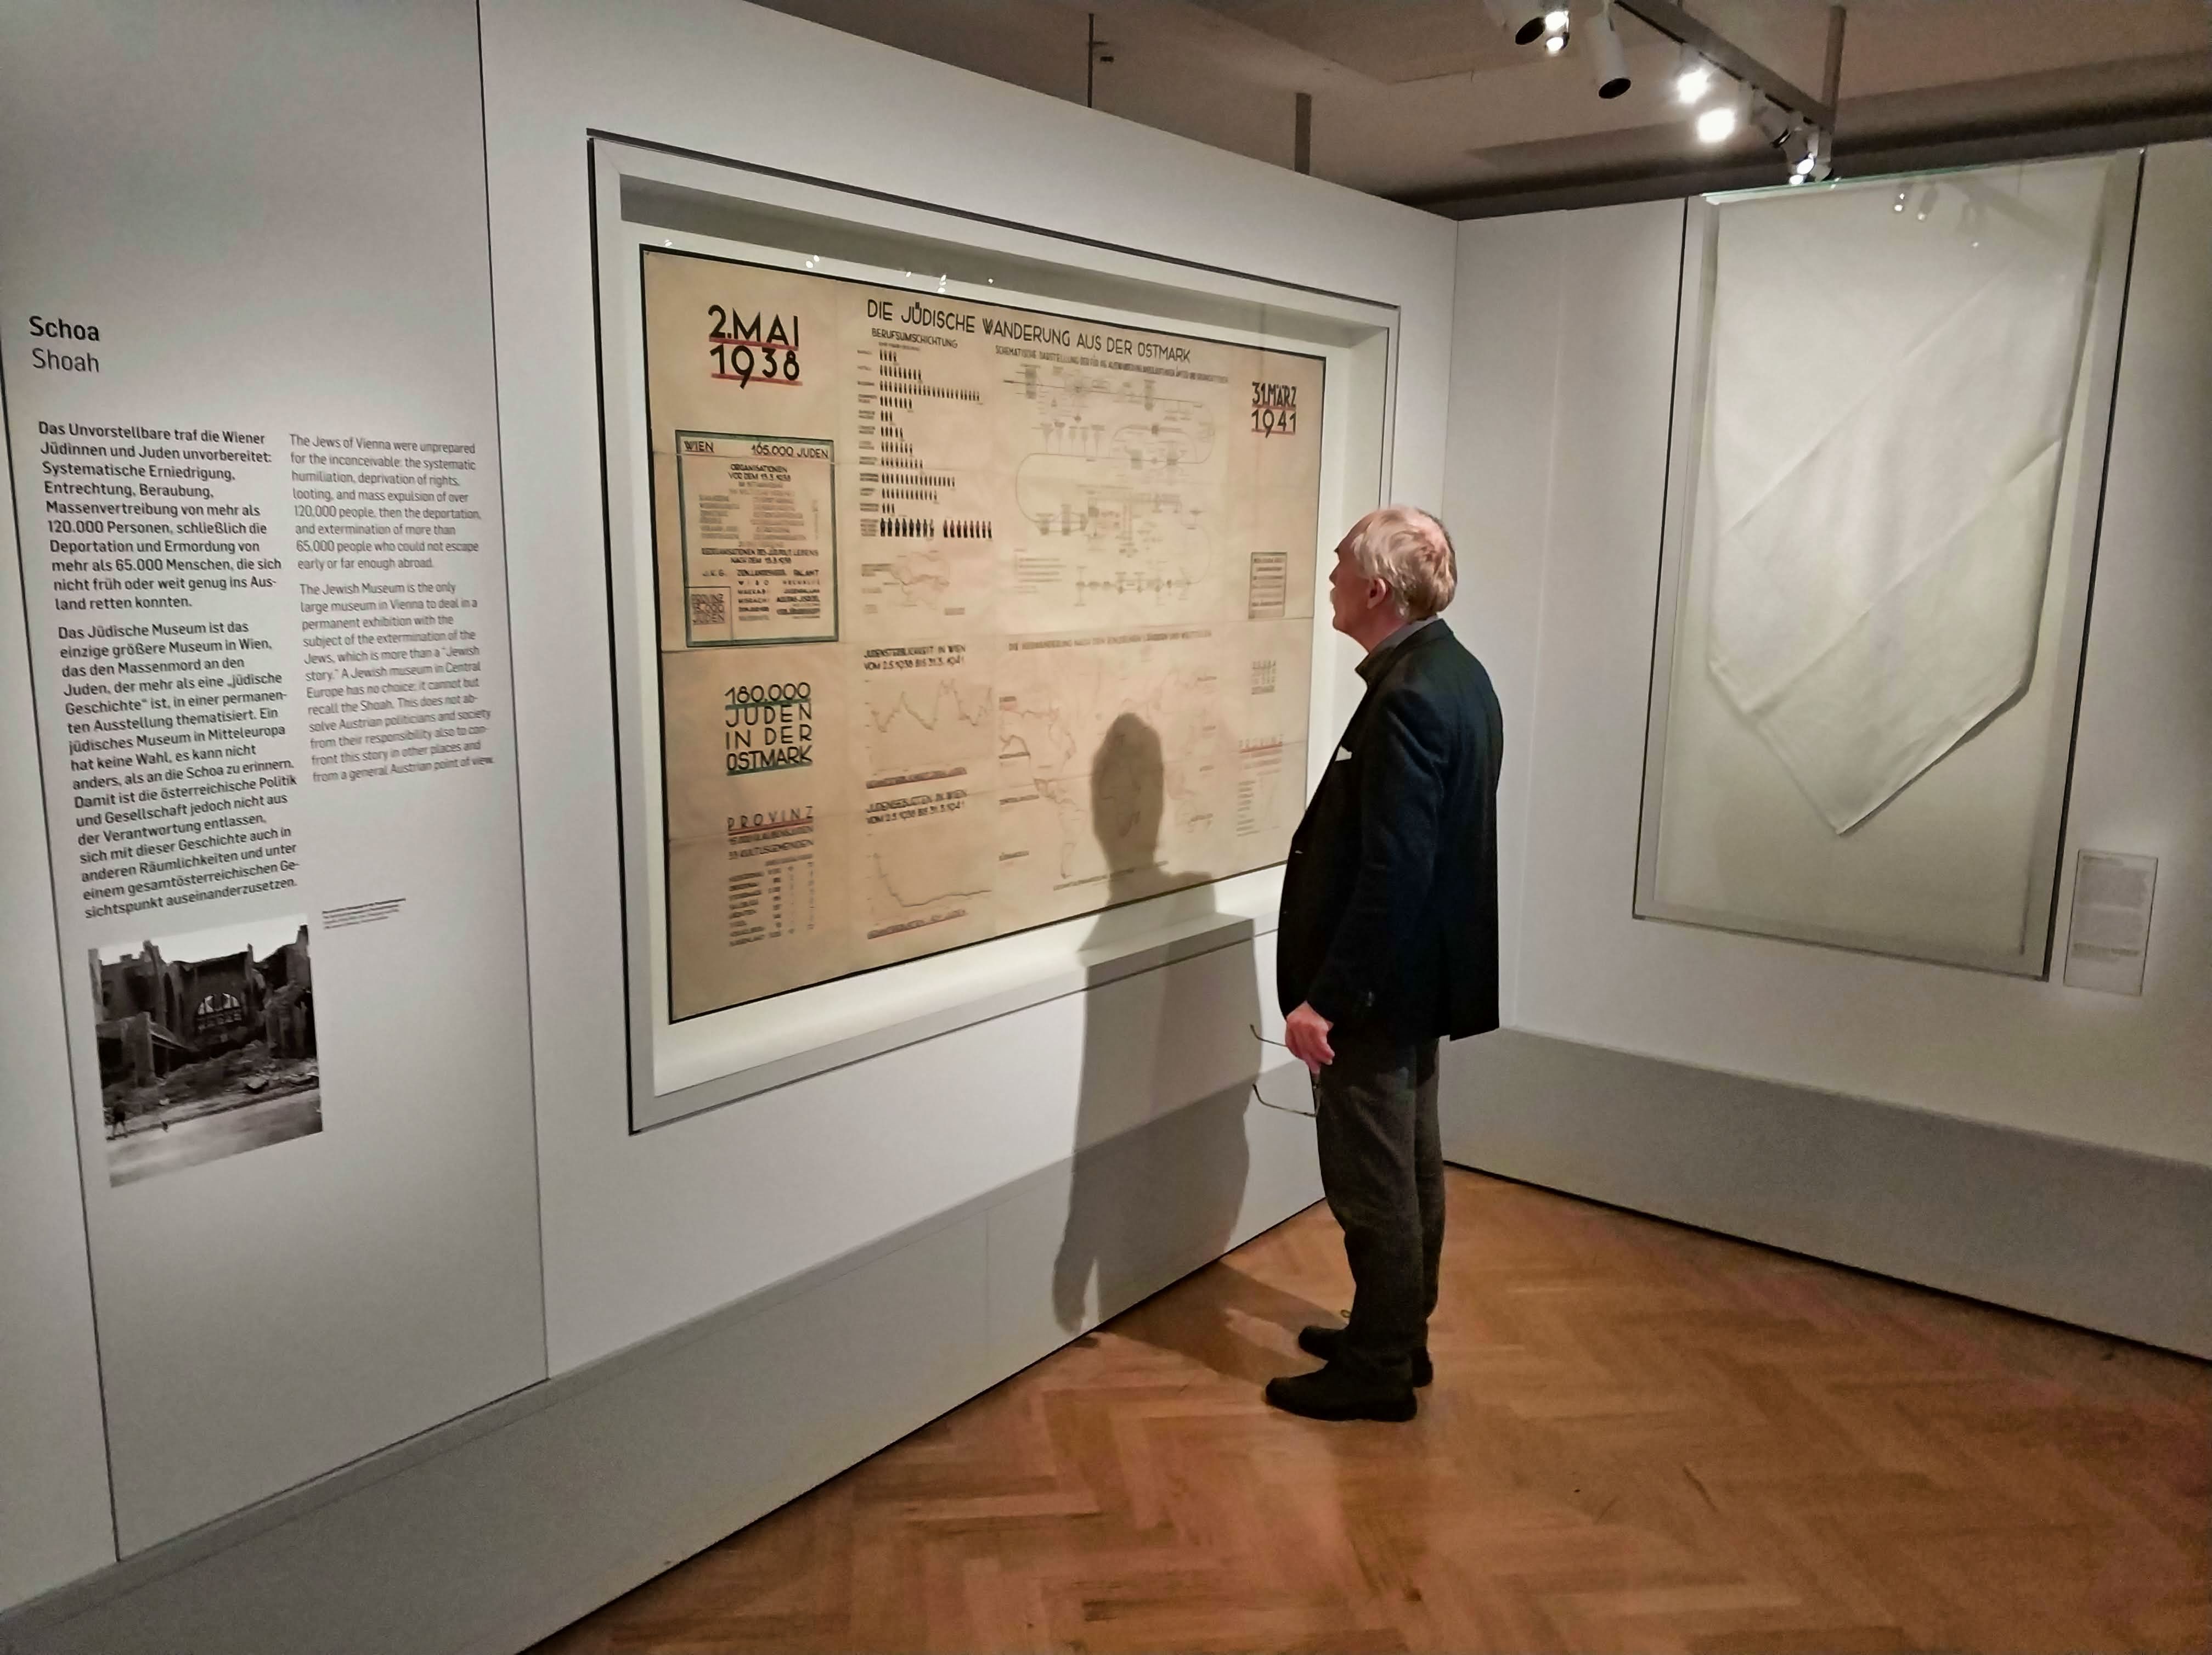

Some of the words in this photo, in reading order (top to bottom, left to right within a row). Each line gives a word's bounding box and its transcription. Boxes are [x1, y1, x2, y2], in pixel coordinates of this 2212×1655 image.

[30, 316, 100, 341] Schoa
[708, 305, 799, 347] 2.MAI
[867, 299, 893, 321] DIE
[901, 302, 975, 333] JÜDISCHE
[982, 318, 1070, 347] WANDERUNG
[1076, 333, 1102, 351] AUS
[1107, 337, 1132, 355] DER
[1138, 342, 1190, 363] OSTMARK
[871, 328, 958, 348] BERUFSUMSCHICHTUNG
[32, 347, 99, 372] Shoah
[709, 344, 800, 390] 1938
[38, 421, 66, 436] Das
[69, 423, 171, 441] Unvorstellbare
[174, 429, 198, 442] traf
[200, 429, 220, 443] die
[222, 430, 266, 445] Wiener
[1251, 408, 1296, 438] 1941
[40, 442, 108, 457] Jüdinnen
[110, 445, 136, 458] und
[138, 445, 180, 460] Juden
[290, 433, 311, 447] The
[312, 435, 342, 448] Jews
[342, 436, 354, 449] of
[355, 437, 392, 451] Vienna
[392, 442, 418, 452] were
[419, 443, 476, 454] unprepared
[684, 441, 715, 453] WIEN
[797, 447, 828, 459] JUDEN
[42, 461, 146, 477] Systematische
[289, 451, 307, 465] for
[308, 453, 328, 465] the
[404, 457, 422, 469] the
[423, 459, 476, 471] systematic
[357, 472, 416, 486] deprivation
[416, 474, 427, 486] of
[336, 489, 356, 500] and
[358, 492, 387, 501] mass
[387, 490, 436, 504] expulsion
[436, 491, 447, 503] of
[448, 493, 469, 503] over
[46, 500, 179, 519] Massenvertreibung
[180, 505, 205, 516] von
[206, 504, 239, 516] mehr
[241, 504, 261, 517] als
[378, 506, 403, 519] then
[404, 507, 421, 519] the
[49, 519, 104, 534] 120.000
[176, 521, 247, 534] schließlich
[249, 522, 267, 534] die
[295, 523, 316, 535] and
[392, 523, 403, 536] of
[405, 526, 431, 536] more
[433, 525, 456, 536] than
[49, 539, 134, 555] Deportation
[136, 539, 162, 553] und
[164, 539, 236, 555] Ermordung
[237, 543, 260, 553] von
[336, 540, 373, 554] people
[374, 541, 397, 552] who
[397, 540, 426, 552] could
[427, 541, 444, 551] not
[445, 543, 479, 553] escape
[52, 559, 89, 572] mehr
[92, 559, 113, 572] als
[115, 558, 163, 572] 65.000
[236, 558, 255, 570] die
[257, 558, 281, 570] sich
[297, 558, 325, 572] early
[326, 560, 338, 569] or
[340, 557, 356, 569] far
[357, 557, 397, 571] enough
[53, 578, 90, 592] nicht
[92, 577, 122, 591] früh
[124, 577, 155, 590] oder
[157, 577, 186, 590] weit
[188, 579, 227, 592] genug
[229, 576, 247, 588] ins
[250, 575, 277, 588] Aus-
[55, 598, 87, 611] land
[89, 598, 132, 610] retten
[58, 626, 85, 639] Das
[87, 624, 150, 639] Jüdische
[152, 623, 207, 636] Museum
[208, 621, 225, 634] ist
[227, 621, 250, 633] das
[60, 645, 110, 660] einzige
[112, 642, 166, 659] größere
[168, 640, 223, 654] Museum
[225, 639, 237, 651] in
[61, 665, 87, 678] das
[89, 663, 115, 676] den
[118, 658, 201, 674] Massenmord
[204, 661, 220, 670] an
[222, 657, 245, 669] den
[114, 681, 136, 694] der
[139, 678, 173, 692] mehr
[176, 677, 196, 690] als
[198, 676, 224, 688] eine
[226, 672, 283, 689] „jüdische
[65, 698, 148, 716] Geschichte“
[173, 696, 186, 708] in
[188, 695, 220, 707] einer
[222, 693, 287, 707] permanen-
[726, 700, 812, 728] JUDEN
[67, 722, 91, 734] ten
[93, 716, 173, 732] Ausstellung
[259, 707, 279, 719] Ein
[69, 737, 134, 756] jüdisches
[136, 734, 191, 747] Museum
[194, 730, 206, 742] in
[207, 725, 286, 741] Mitteleuropa
[726, 729, 751, 750] IN
[765, 724, 812, 746] DER
[727, 745, 812, 770] OSTMARK
